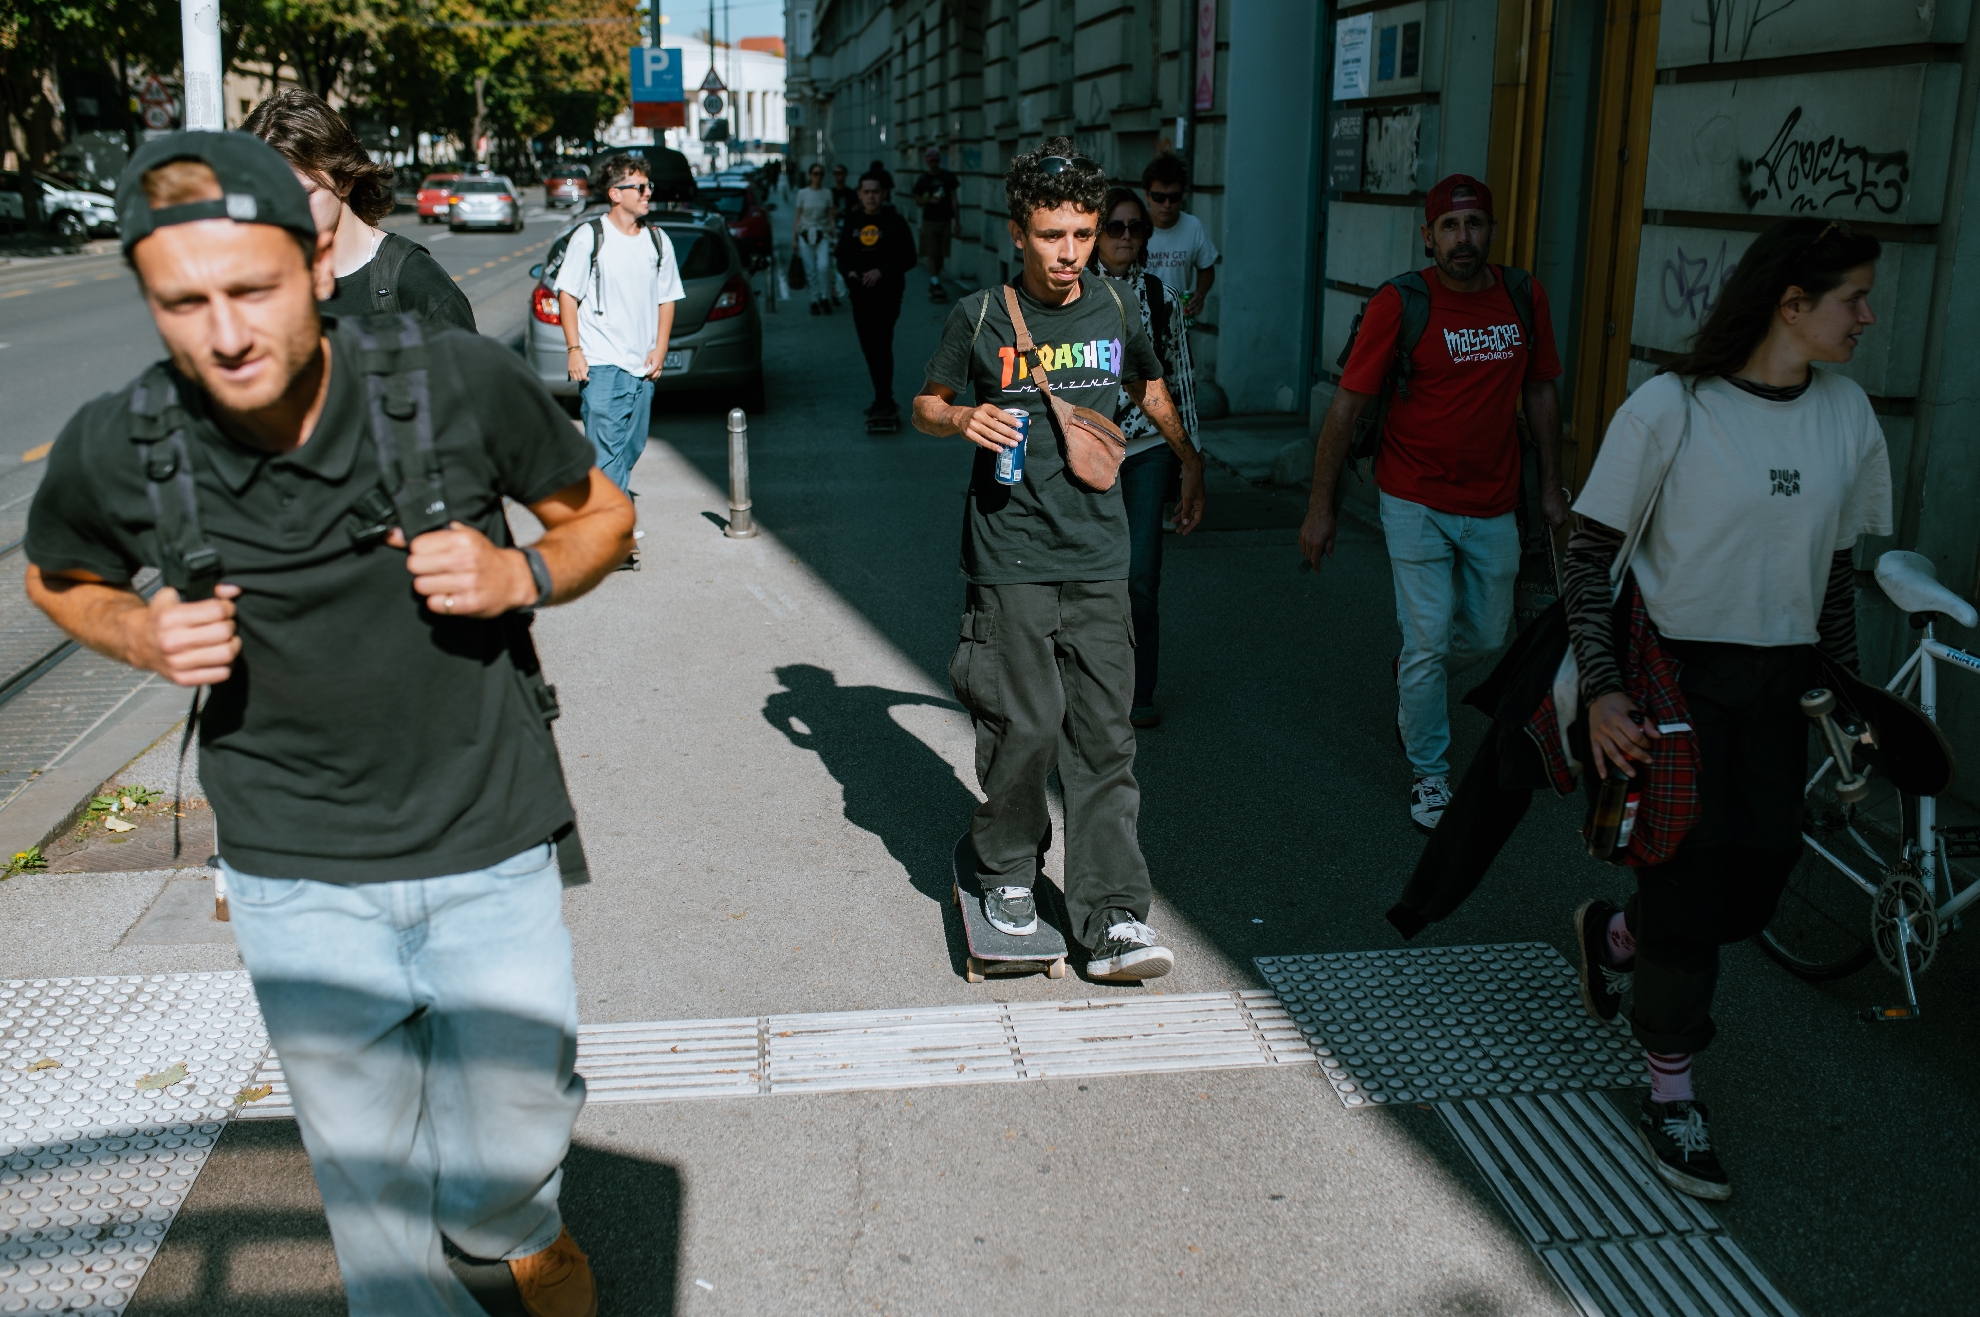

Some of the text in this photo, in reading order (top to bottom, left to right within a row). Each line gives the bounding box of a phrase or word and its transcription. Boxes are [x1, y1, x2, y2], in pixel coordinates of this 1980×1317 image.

[643, 48, 669, 87] P
[1146, 251, 1187, 260] AMEN GET
[1146, 260, 1187, 269] OUR LOVE
[1453, 350, 1514, 364] SKATEBOARDS
[1771, 481, 1800, 496] JAGA
